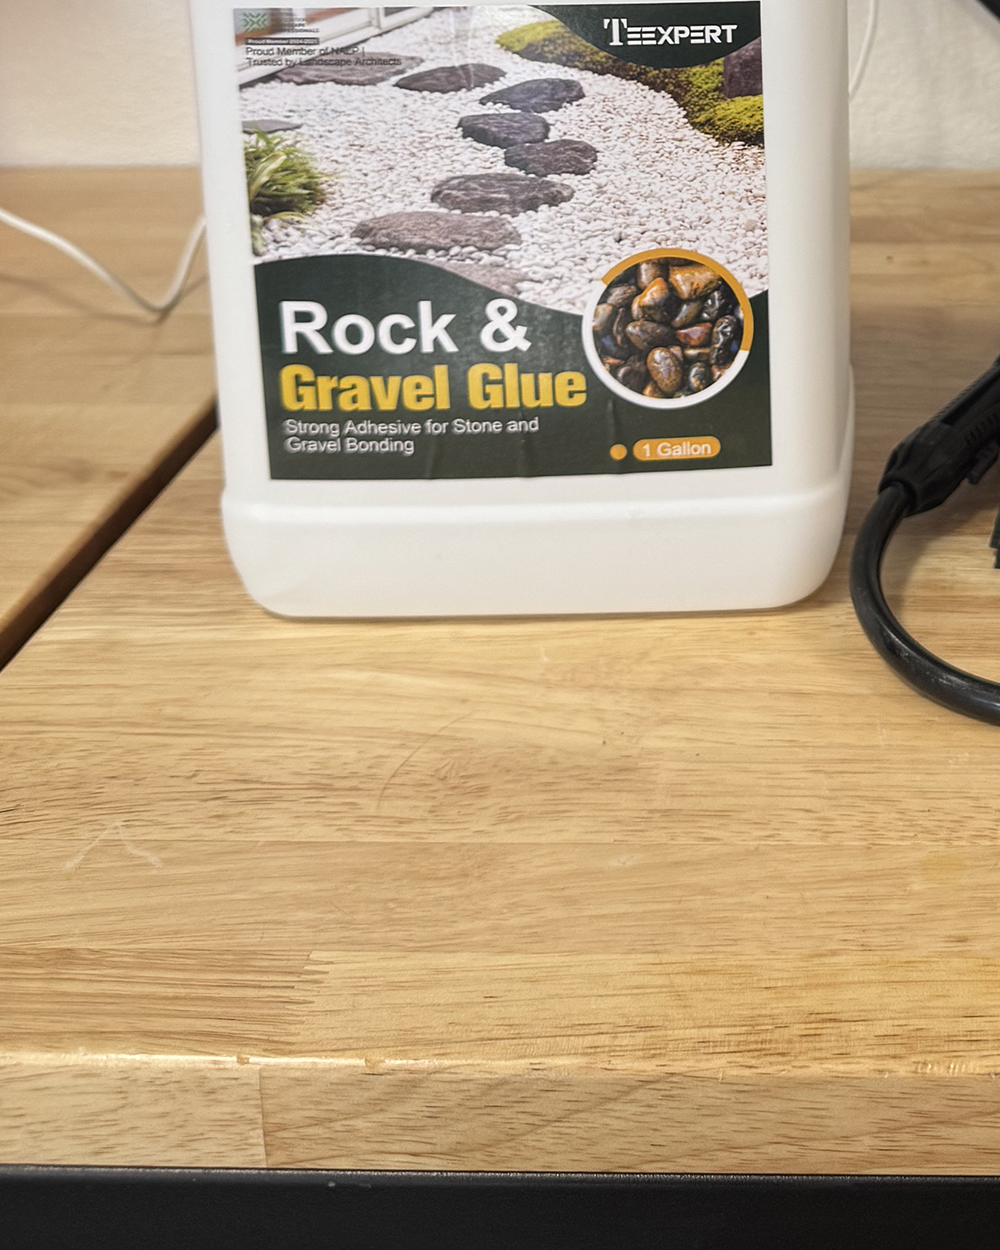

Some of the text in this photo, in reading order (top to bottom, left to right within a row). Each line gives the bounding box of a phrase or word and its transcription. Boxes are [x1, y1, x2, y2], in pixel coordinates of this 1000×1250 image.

[245, 46, 275, 56] Proud
[277, 46, 316, 56] Member
[246, 56, 403, 68] Trusted by Landscape Architects
[280, 298, 532, 355] Rock &
[279, 362, 587, 411] Gravel Glue
[284, 417, 539, 438] Strong Adhesive for Stone and
[284, 437, 414, 456] Gravel Bonding
[643, 440, 712, 457] 1 Gallon
